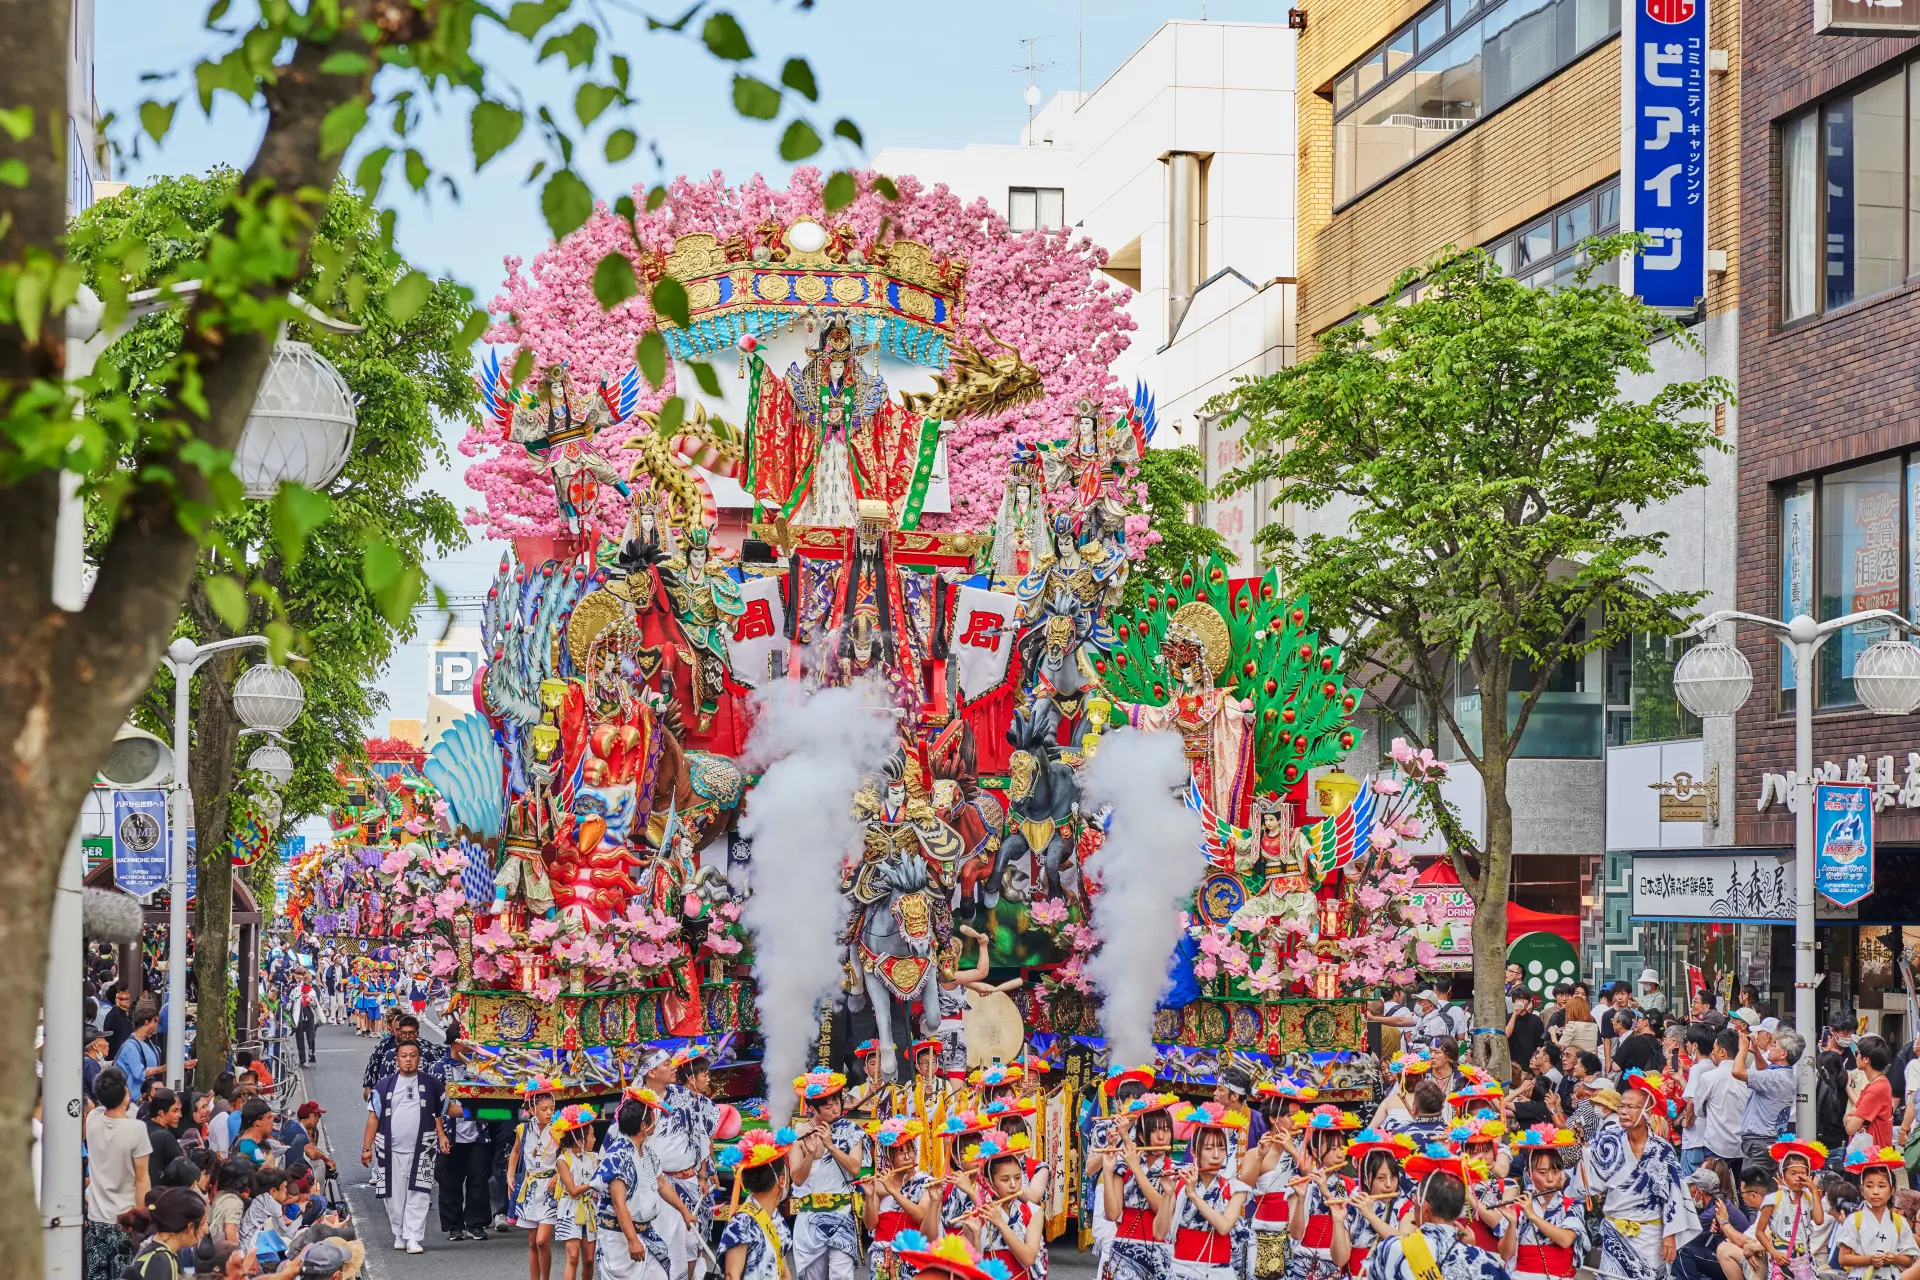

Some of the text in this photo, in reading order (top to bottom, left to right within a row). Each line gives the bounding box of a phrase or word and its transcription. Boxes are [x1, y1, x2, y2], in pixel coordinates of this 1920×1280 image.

[1687, 37, 1701, 205] コミュニティ キャッシング
[1855, 548, 1899, 587] 相談窓
[734, 598, 775, 642] 周
[960, 610, 1004, 652] 周
[443, 657, 473, 691] P
[122, 827, 157, 837] DIME
[1726, 859, 1786, 916] 青森屋
